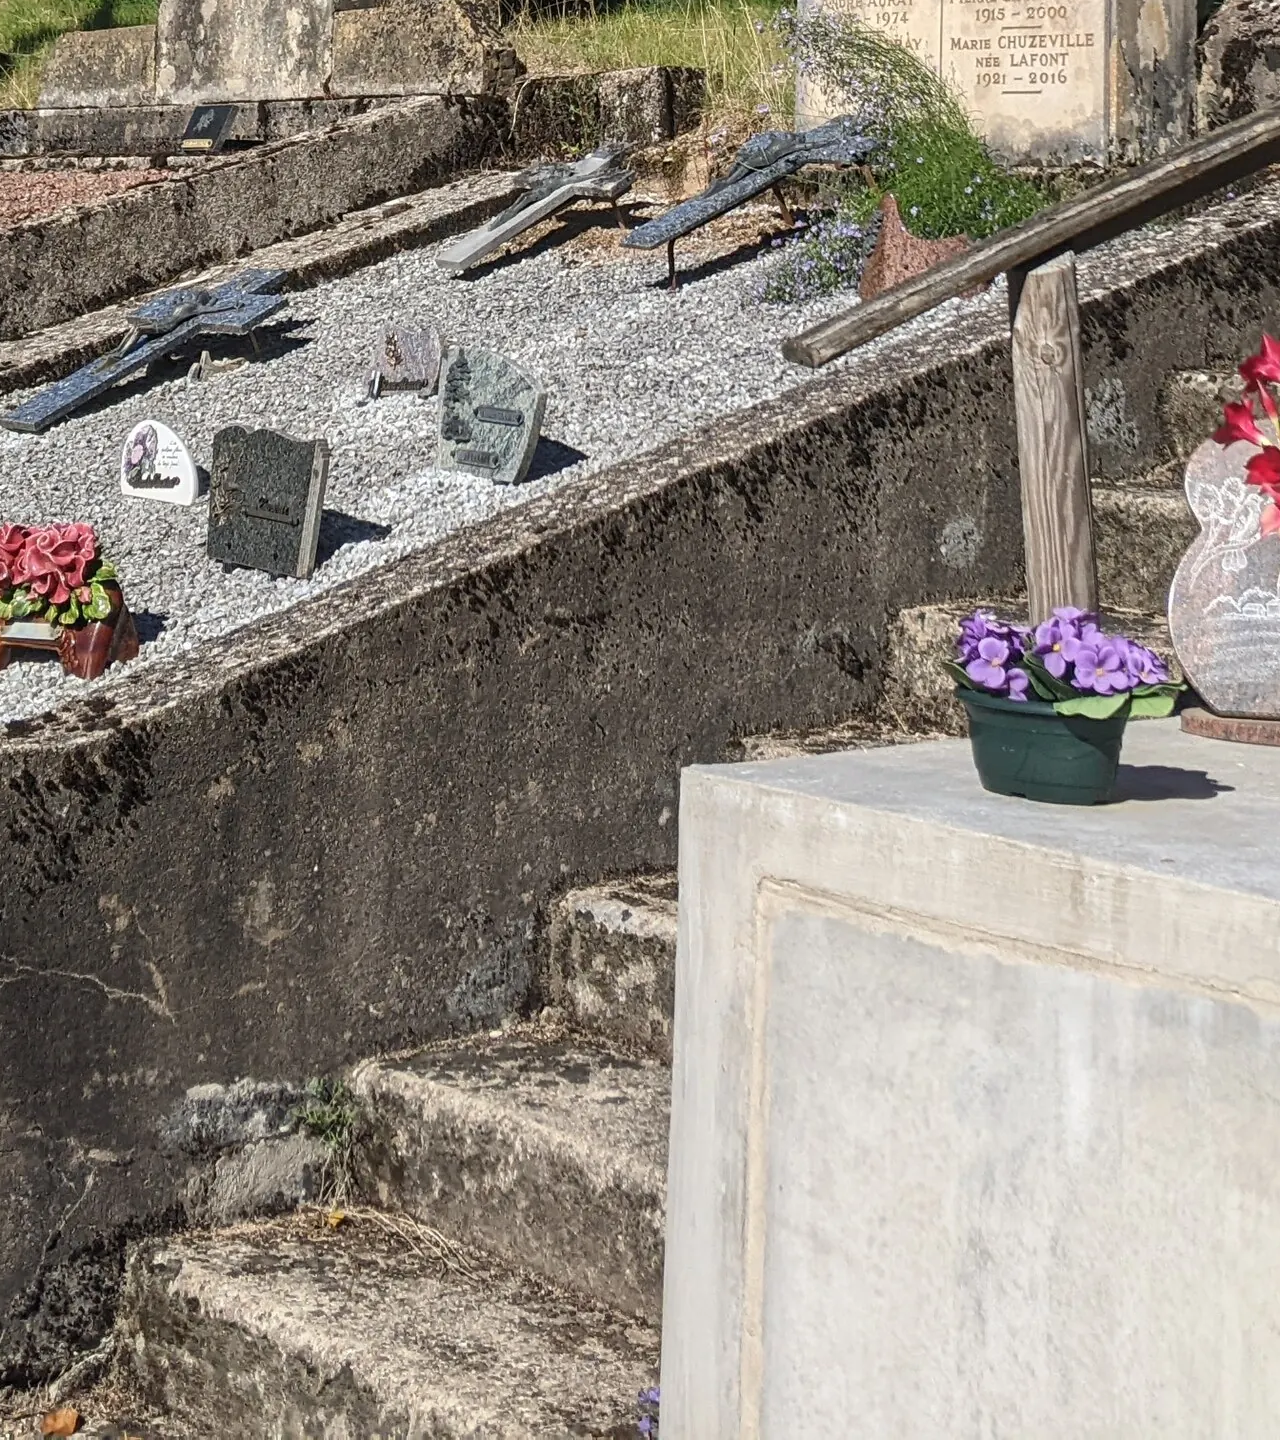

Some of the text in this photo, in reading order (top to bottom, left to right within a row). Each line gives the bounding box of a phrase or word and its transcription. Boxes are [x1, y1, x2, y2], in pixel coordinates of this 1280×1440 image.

[875, 11, 909, 27] 1974
[975, 7, 1006, 24] 1915
[1025, 5, 1068, 20] 2000
[950, 32, 1095, 51] MARIE CHUZEVILLE
[1009, 52, 1070, 68] LAFONT
[976, 72, 1007, 88] 1921
[1028, 68, 1068, 85] 2016
